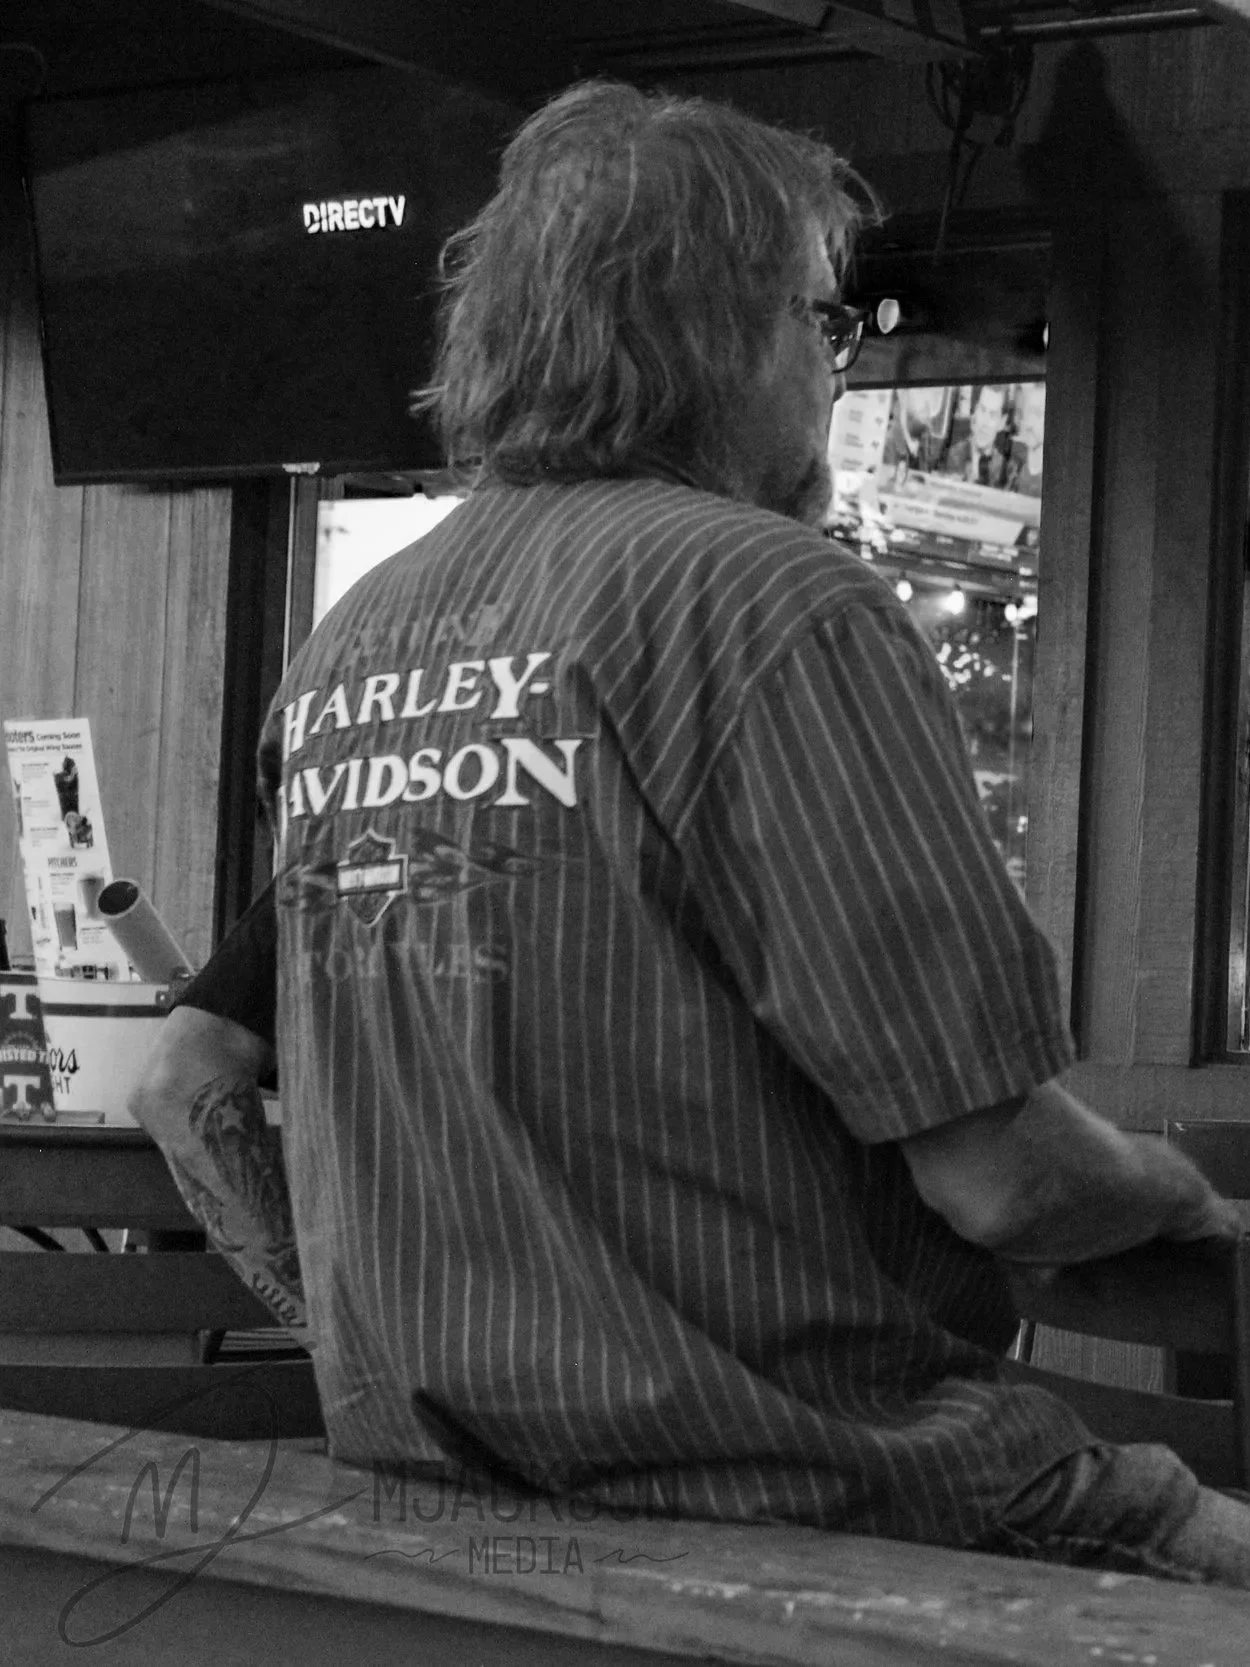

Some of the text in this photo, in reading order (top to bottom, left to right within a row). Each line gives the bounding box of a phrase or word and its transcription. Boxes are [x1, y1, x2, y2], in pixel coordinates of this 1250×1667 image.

[303, 195, 405, 234] DIRECTV
[4, 730, 35, 744] ooters
[281, 651, 552, 763] HARLEY-
[276, 738, 583, 820] AVIDSON
